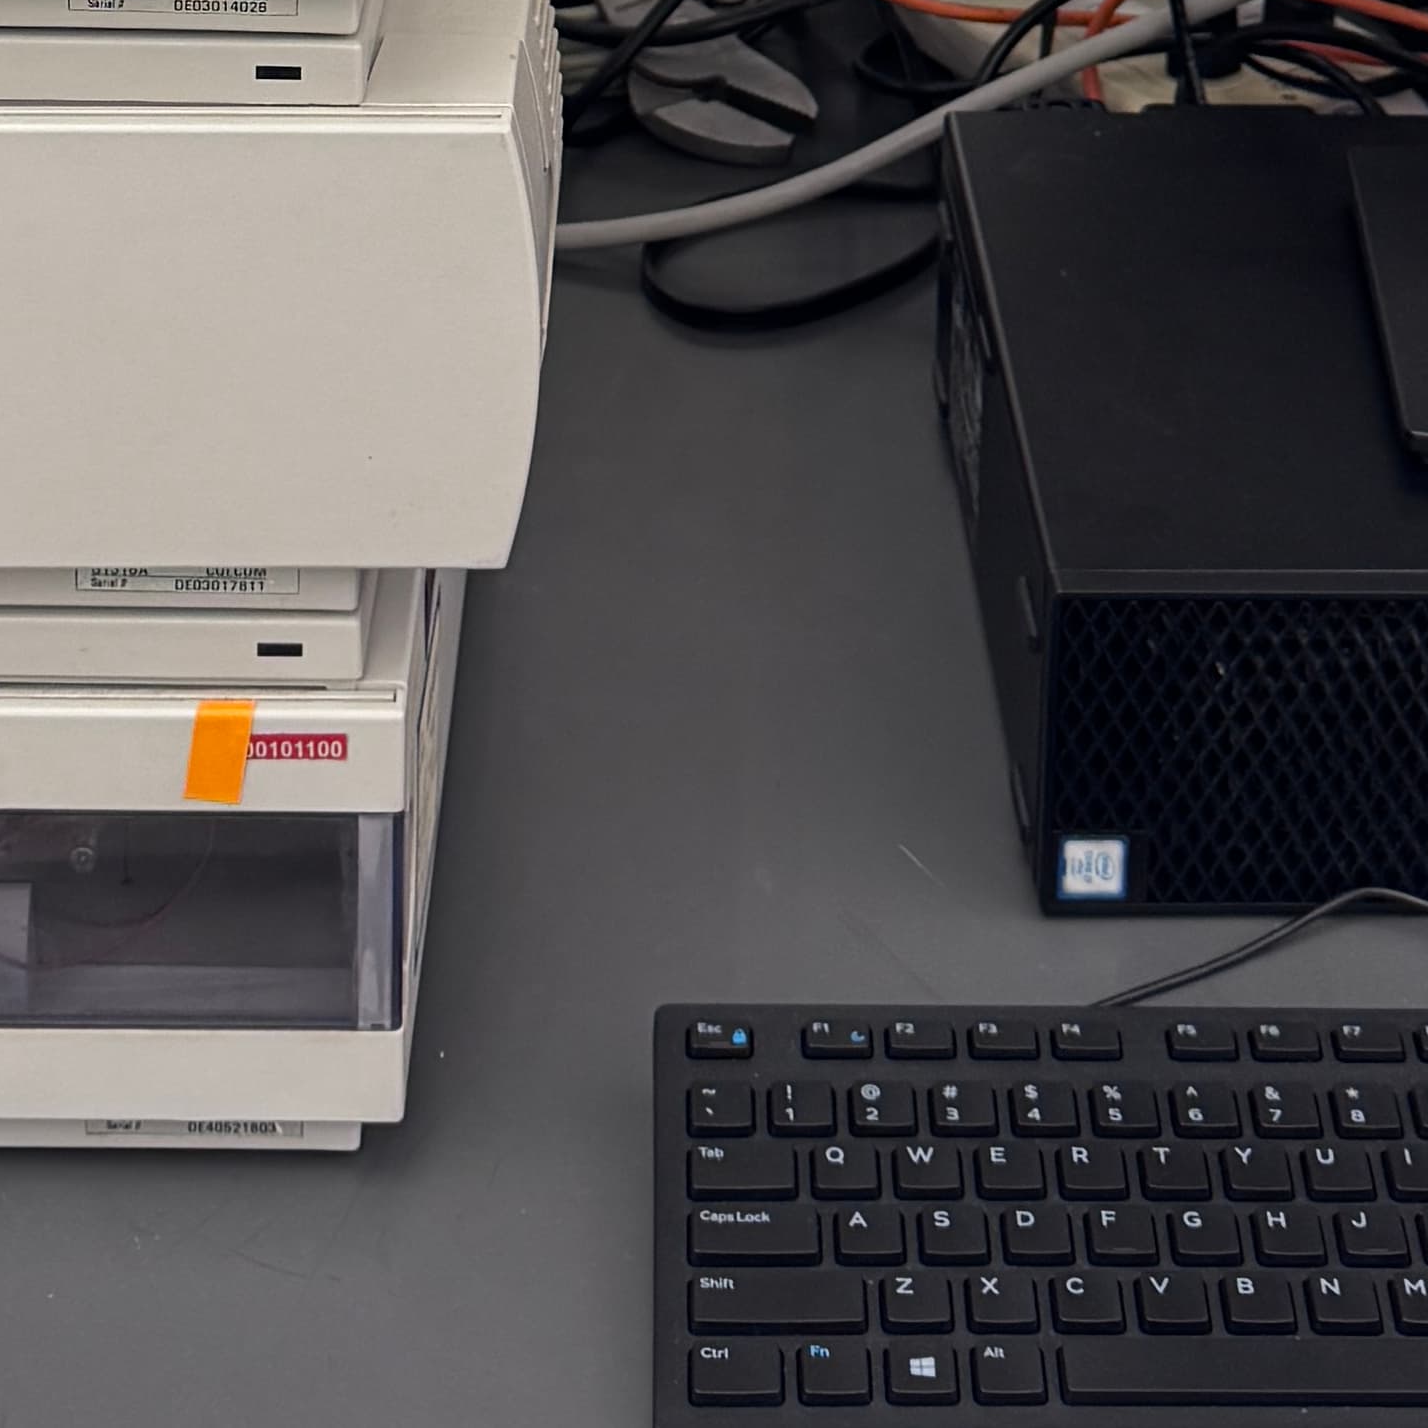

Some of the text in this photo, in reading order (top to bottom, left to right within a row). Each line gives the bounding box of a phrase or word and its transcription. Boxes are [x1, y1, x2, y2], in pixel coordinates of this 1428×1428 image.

[90, 578, 117, 588] Serial
[697, 1022, 722, 1034] Esc
[698, 1146, 725, 1161] Tab
[825, 1146, 845, 1165] Q
[906, 1145, 934, 1164] W
[989, 1146, 1007, 1164] E
[1071, 1146, 1090, 1164] R
[1151, 1146, 1171, 1165] T
[1234, 1146, 1252, 1165] Y
[1315, 1147, 1335, 1165] U
[699, 1209, 771, 1225] Caps Lock
[848, 1210, 868, 1228] A
[933, 1210, 951, 1228] S
[1015, 1210, 1035, 1228] D
[1100, 1209, 1117, 1227] F
[1182, 1210, 1203, 1228] G
[1266, 1210, 1287, 1229] H
[1351, 1211, 1367, 1229] J
[699, 1276, 735, 1290] Shift
[895, 1276, 914, 1295] Z
[980, 1276, 1000, 1295] X
[1065, 1276, 1085, 1295] C
[1149, 1276, 1170, 1295] V
[1236, 1277, 1255, 1295] B
[1319, 1277, 1341, 1296] N
[1403, 1277, 1427, 1296] M
[699, 1346, 729, 1360] Ctrl
[809, 1344, 830, 1358] Fn
[983, 1346, 1005, 1359] Alt
